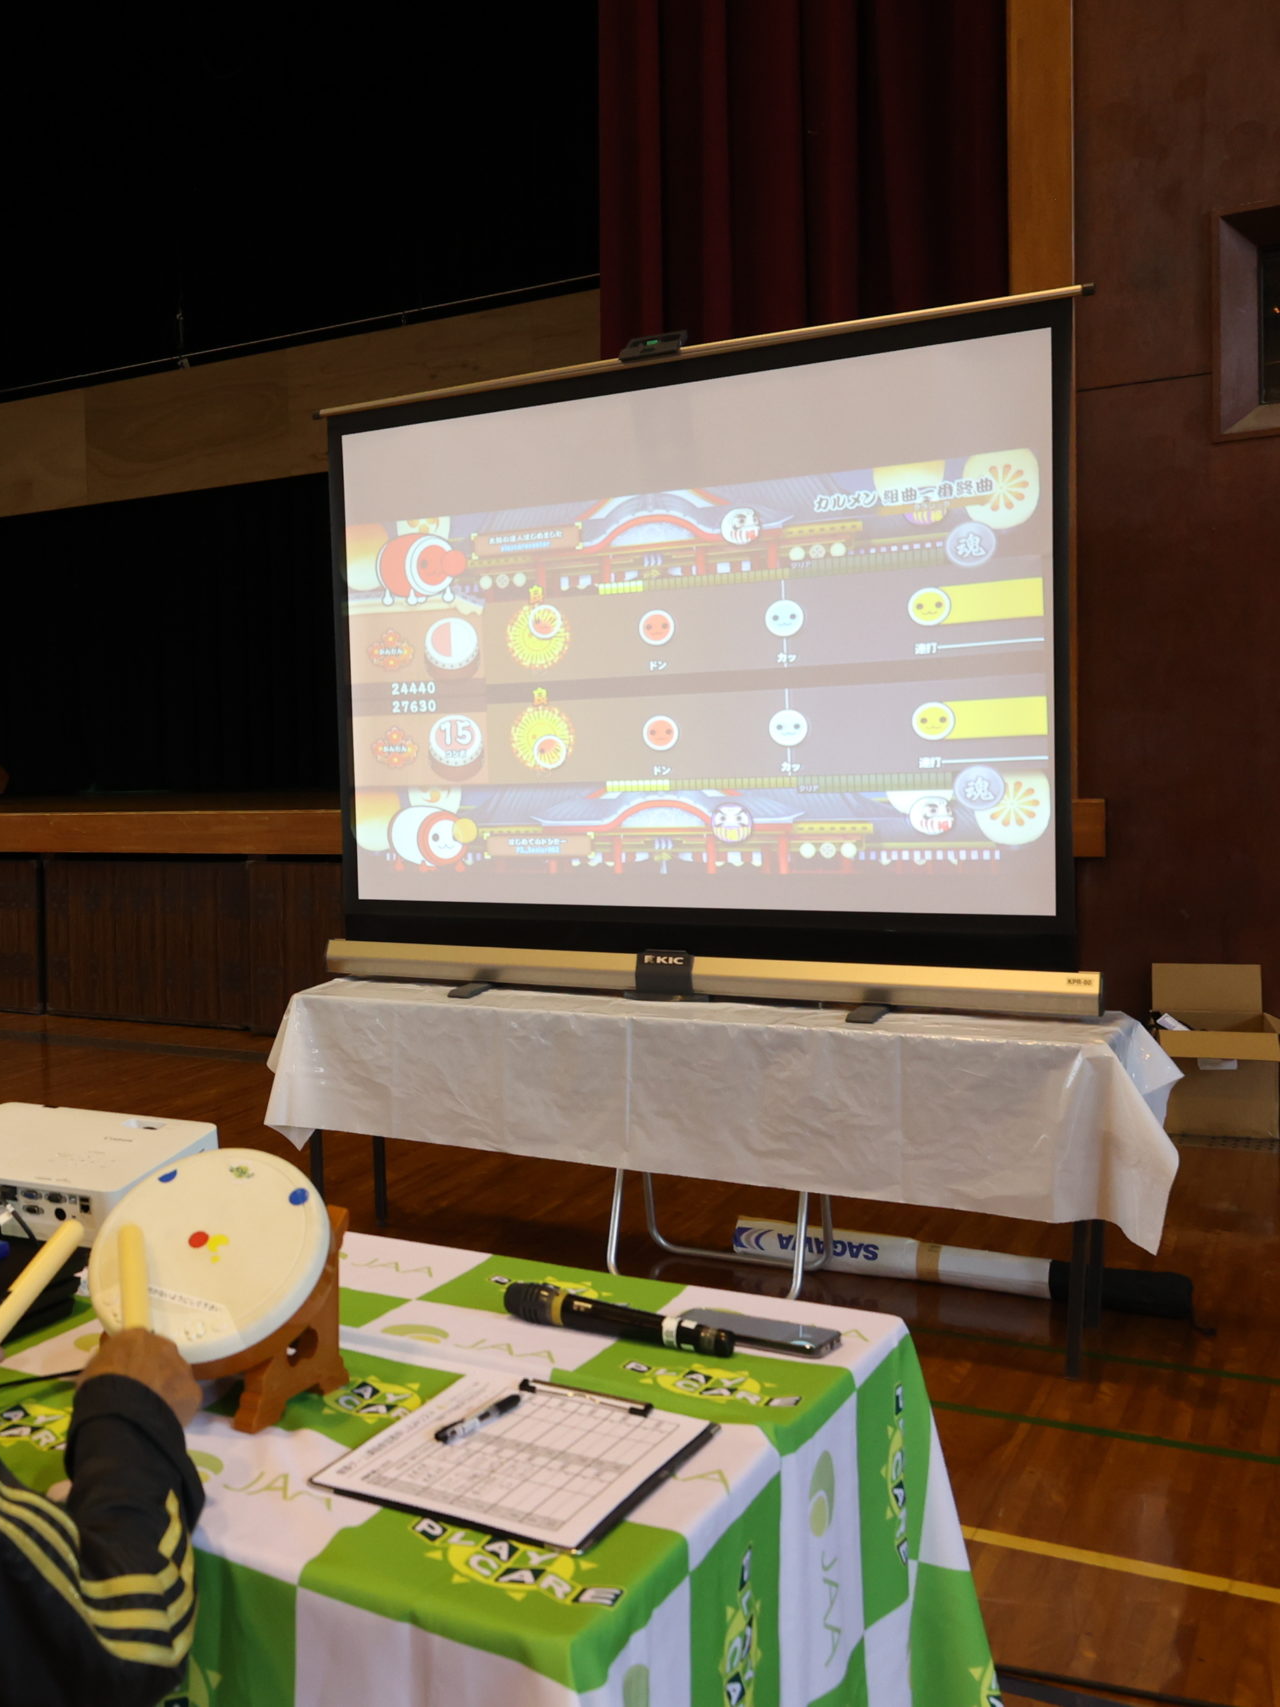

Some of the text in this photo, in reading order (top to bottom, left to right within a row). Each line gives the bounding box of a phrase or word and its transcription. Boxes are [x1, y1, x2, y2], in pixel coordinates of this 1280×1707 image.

[814, 489, 878, 513] カルメン
[956, 533, 986, 559] 魂
[649, 660, 668, 671] ドン
[777, 652, 797, 664] カッ
[391, 681, 436, 696] 24440
[392, 699, 437, 713] 27630
[439, 719, 473, 746] 15
[653, 765, 671, 776] ドン
[781, 762, 801, 774] カッ
[964, 775, 995, 801] 魂
[656, 956, 684, 965] KIC
[412, 1517, 560, 1562] PLAY
[468, 1554, 624, 1606] CARE
